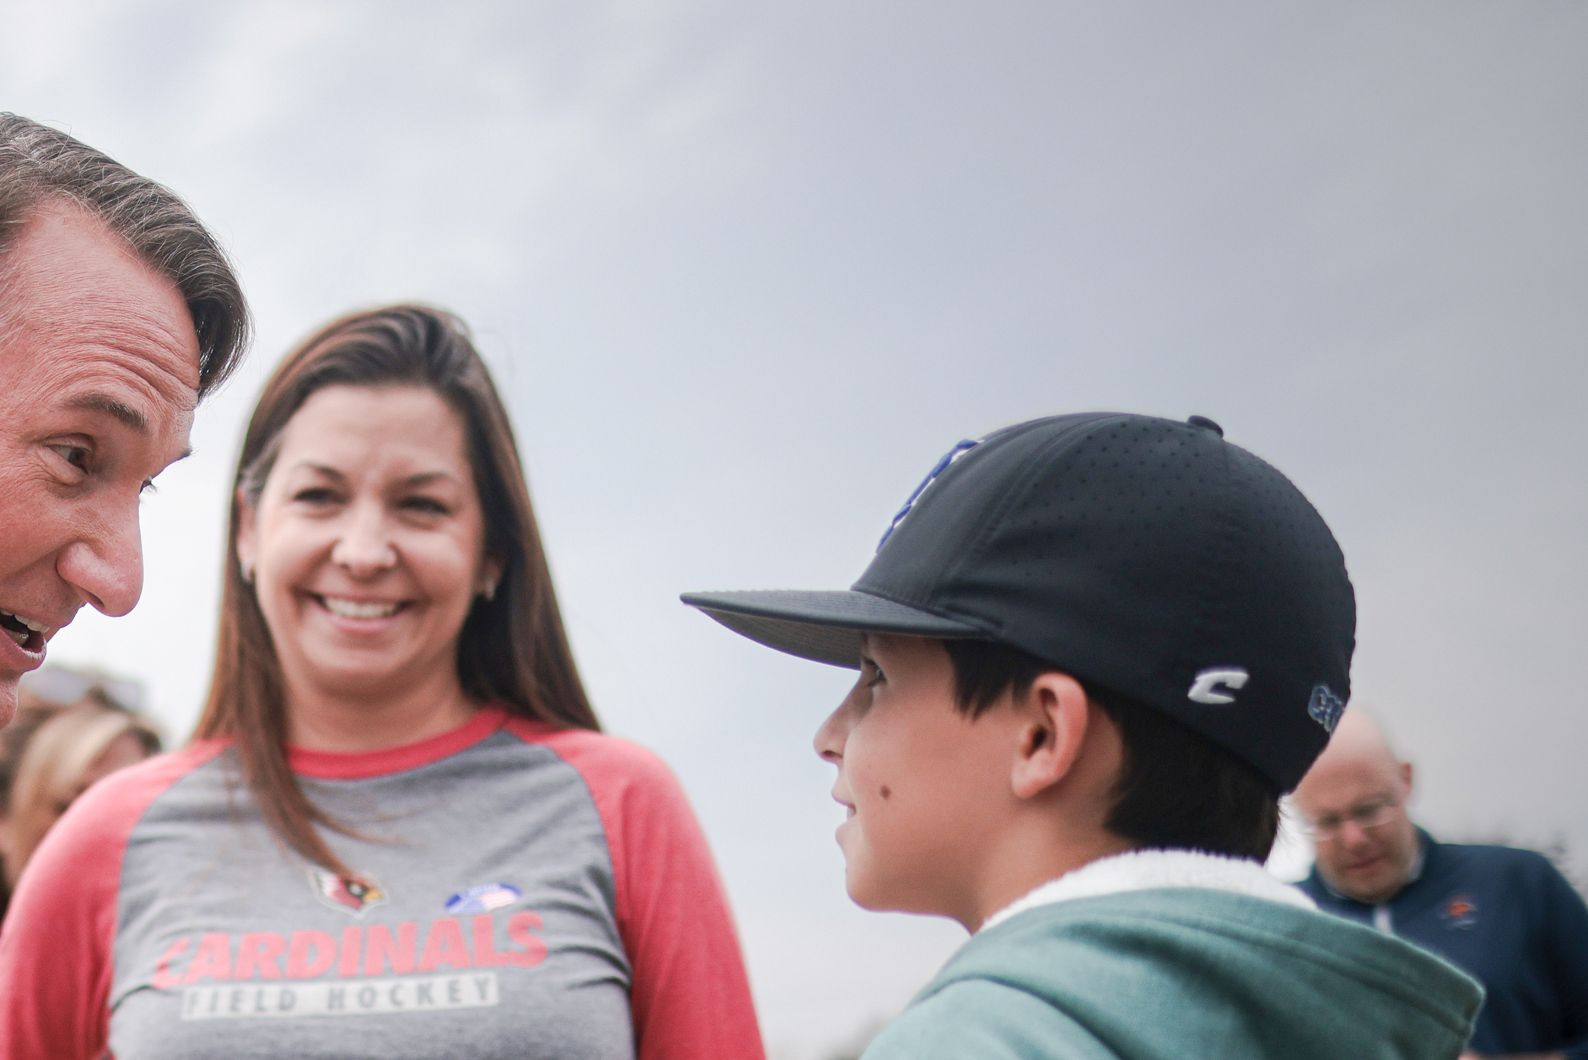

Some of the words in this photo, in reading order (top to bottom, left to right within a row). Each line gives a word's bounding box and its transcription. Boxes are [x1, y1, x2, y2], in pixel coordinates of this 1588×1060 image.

[152, 911, 548, 989] CARDINALS
[184, 986, 298, 1015] FIELD
[328, 978, 491, 1011] HOCKEY
